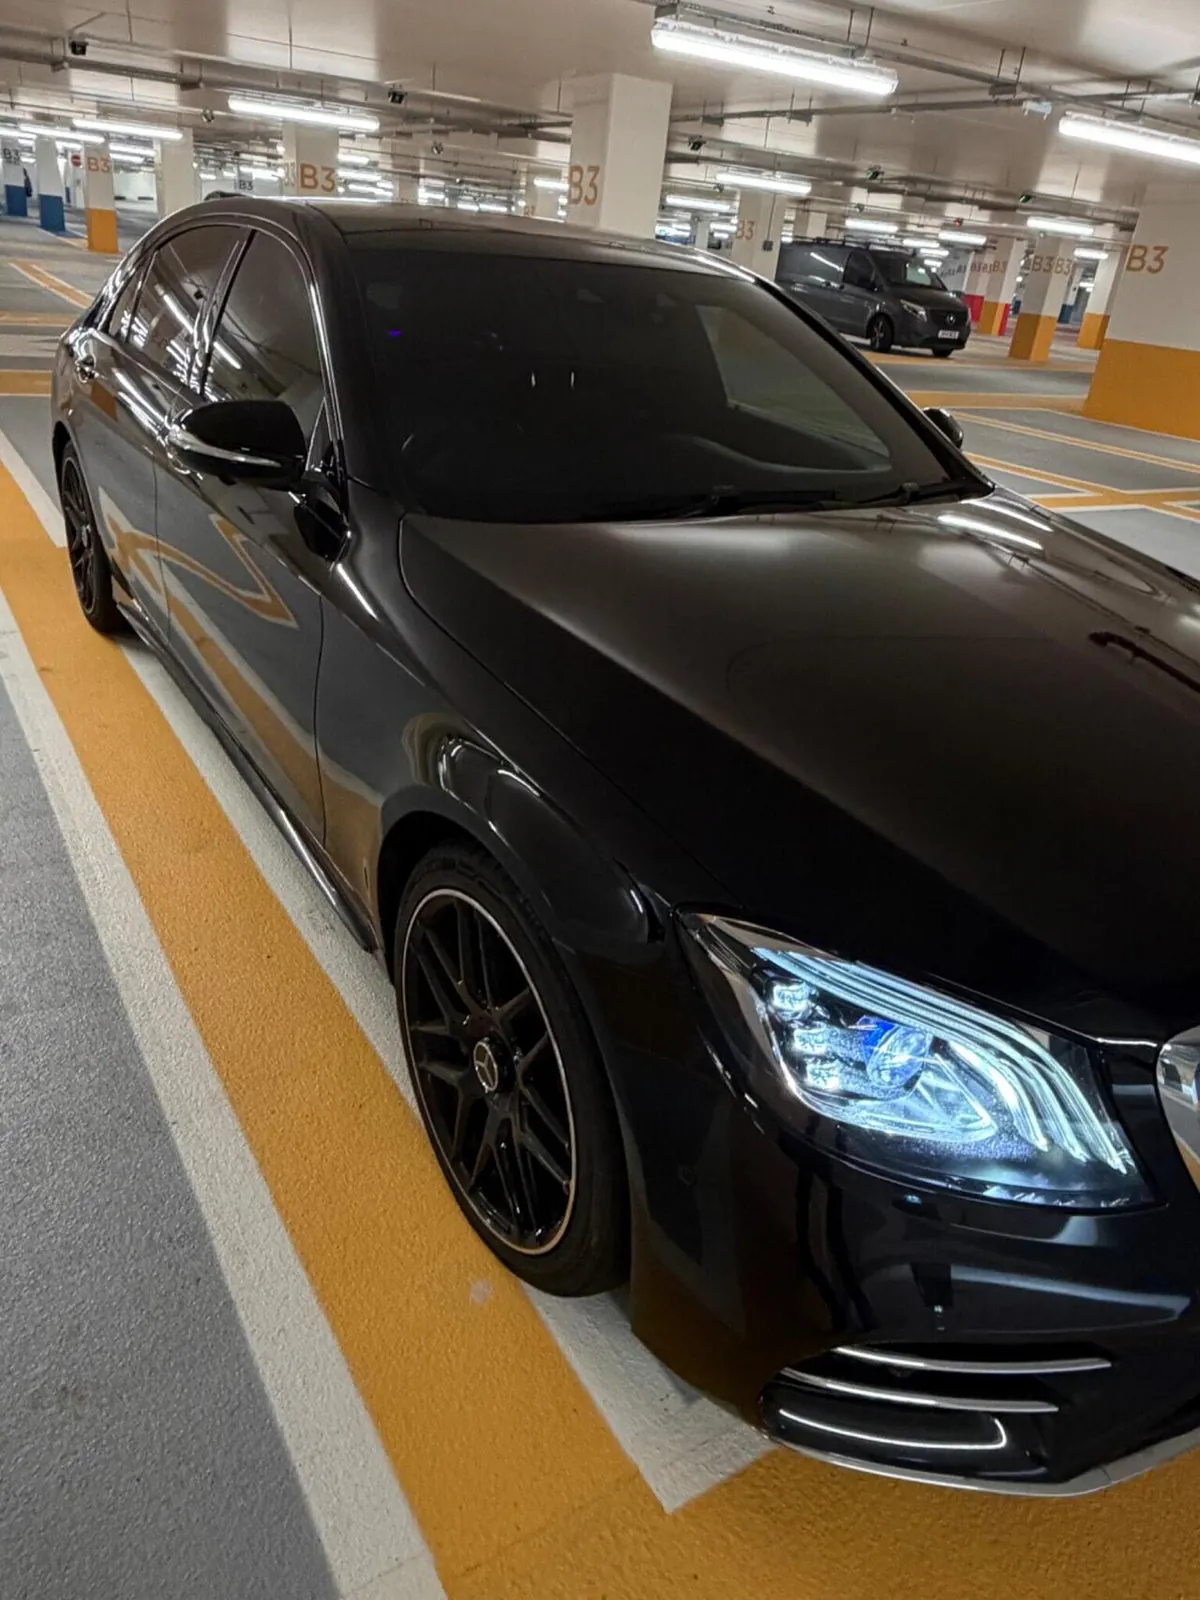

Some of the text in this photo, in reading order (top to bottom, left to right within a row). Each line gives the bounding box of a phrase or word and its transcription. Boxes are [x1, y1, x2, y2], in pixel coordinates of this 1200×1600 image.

[87, 157, 110, 173] B3
[239, 180, 253, 191] B3
[300, 163, 336, 193] B3
[569, 165, 599, 207] B3
[1032, 255, 1053, 273] B3
[1054, 258, 1072, 276] B3
[1126, 244, 1169, 274] B3
